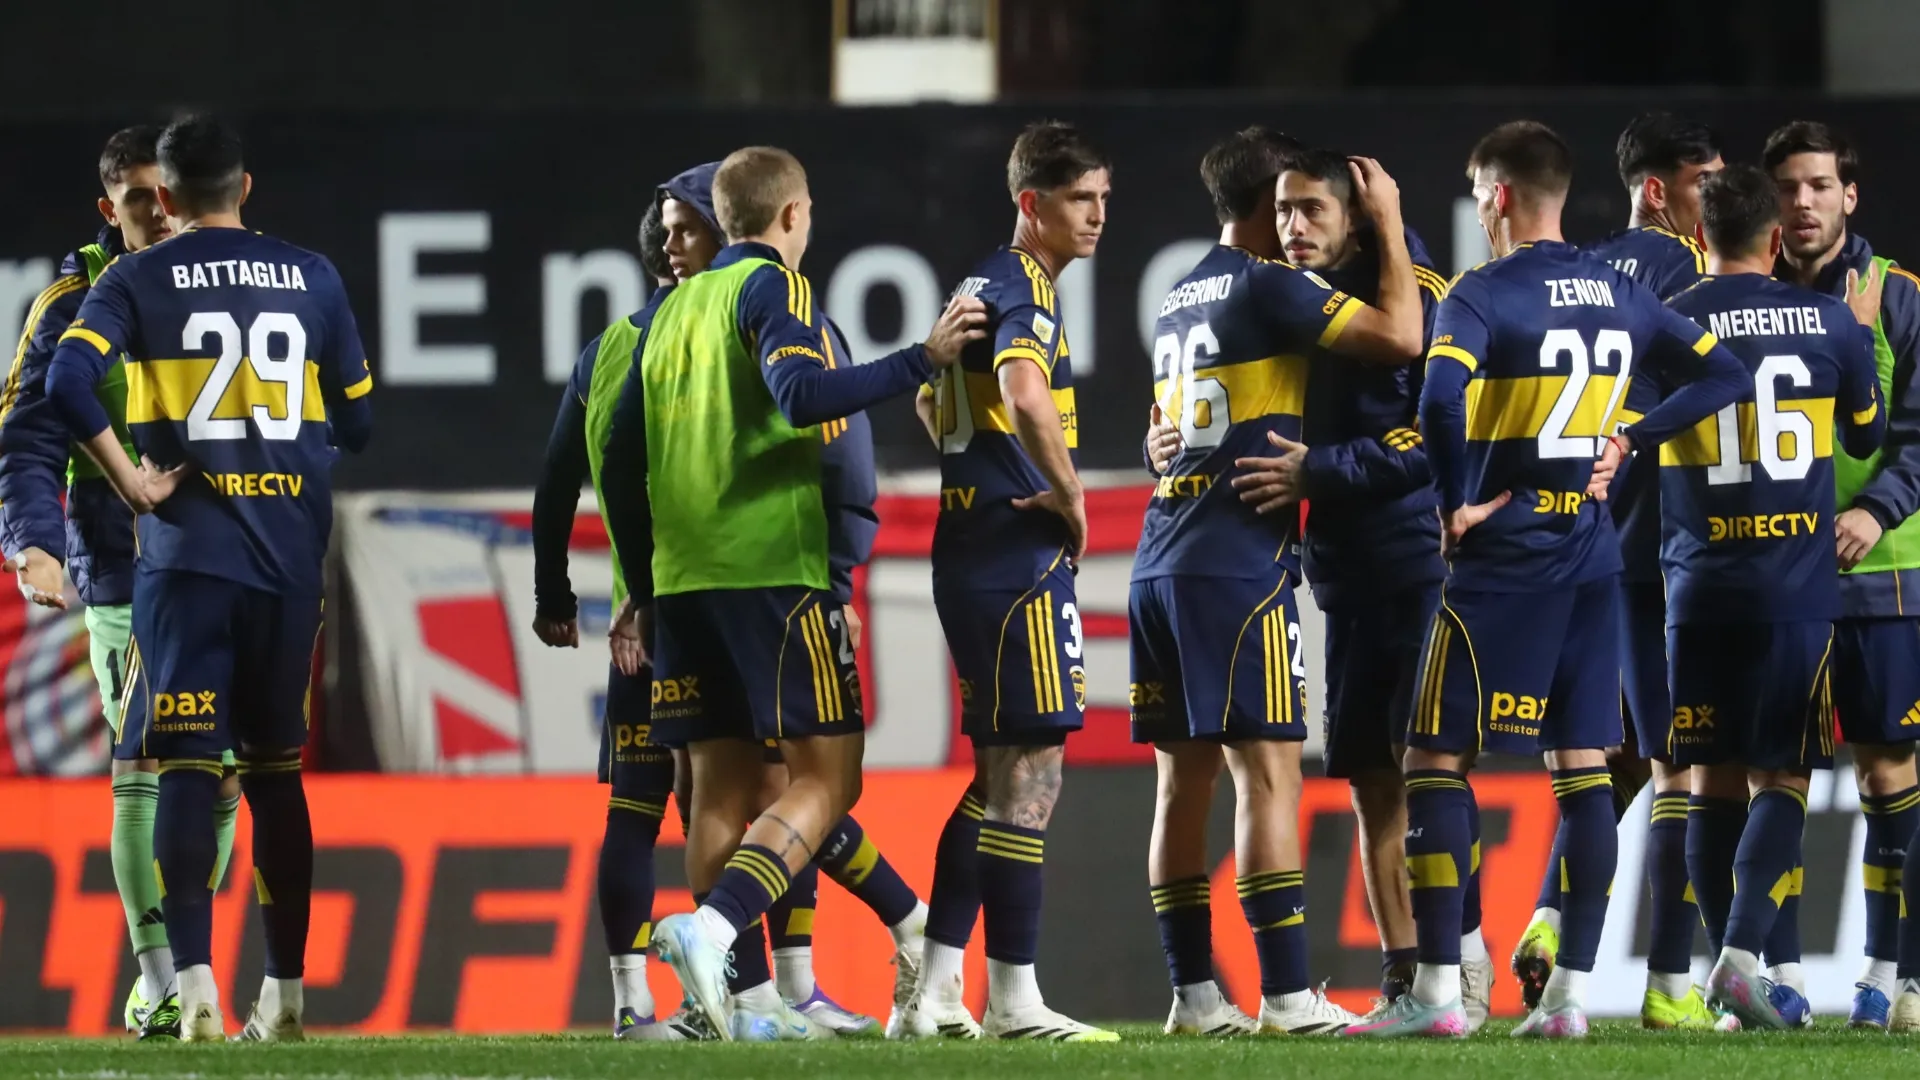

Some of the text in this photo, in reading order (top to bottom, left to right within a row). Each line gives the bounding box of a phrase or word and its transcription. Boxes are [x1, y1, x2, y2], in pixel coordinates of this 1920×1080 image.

[172, 259, 307, 291] BATTAGLIA
[1545, 277, 1615, 308] ZENON
[1708, 306, 1827, 340] MERENTIEL
[182, 311, 306, 441] 29
[1154, 322, 1230, 450] 26
[1537, 329, 1633, 459] 22
[1707, 355, 1814, 486] 16
[1708, 511, 1819, 542] DIRECTV
[153, 689, 217, 723] pax
[653, 676, 700, 710] pax
[153, 721, 216, 732] assistance
